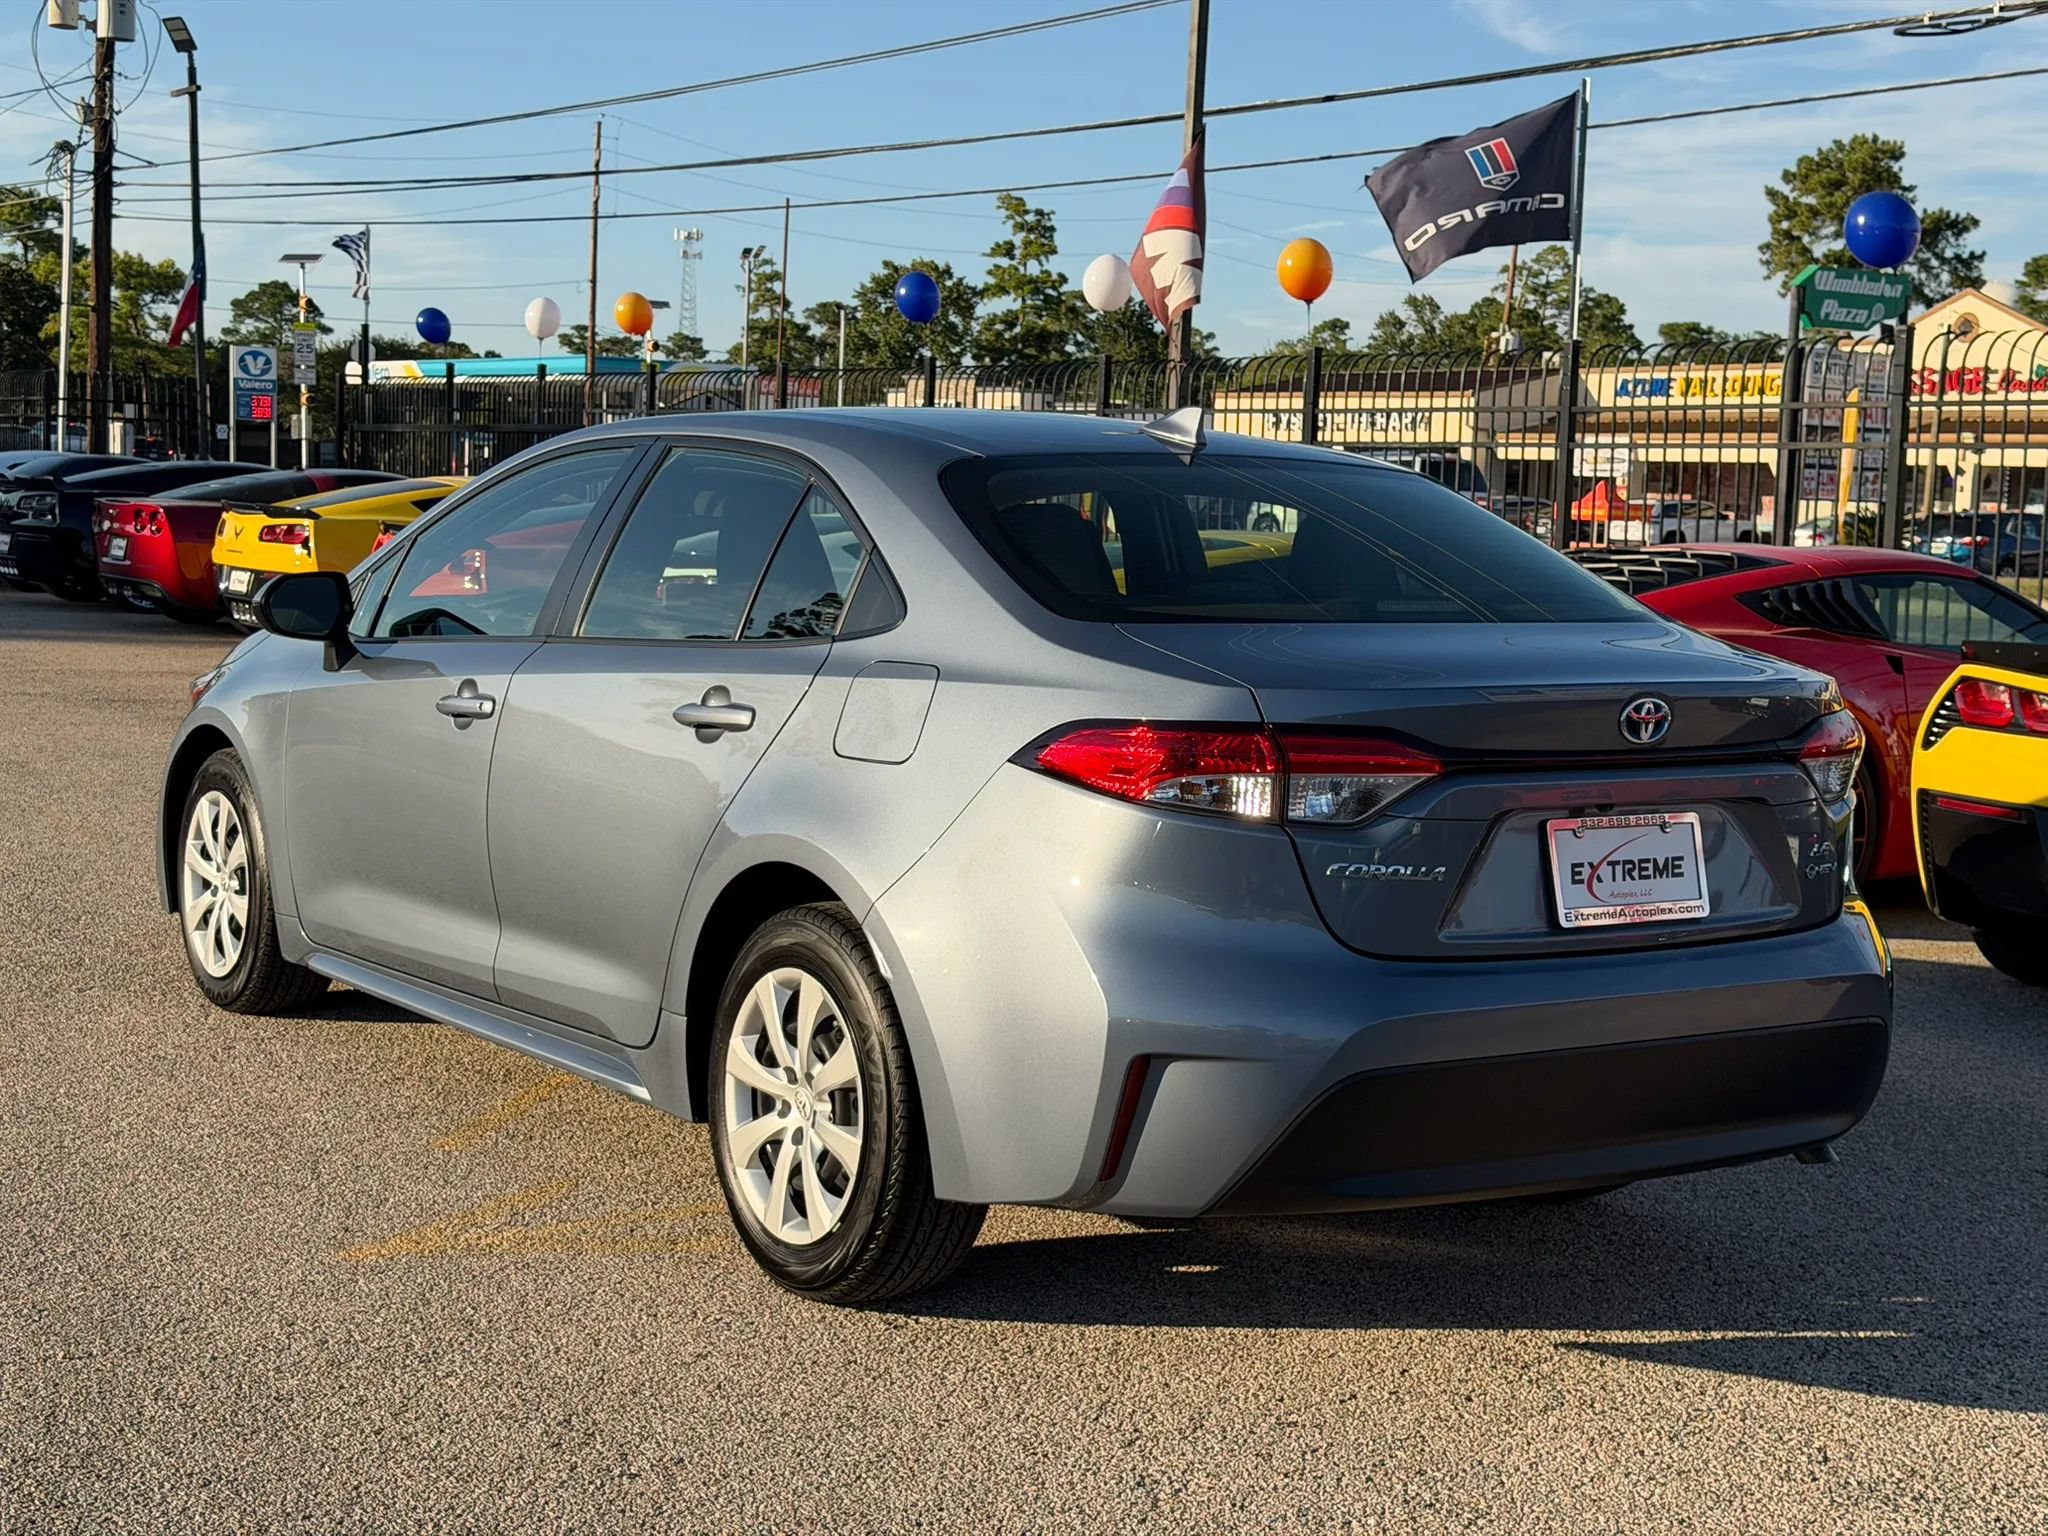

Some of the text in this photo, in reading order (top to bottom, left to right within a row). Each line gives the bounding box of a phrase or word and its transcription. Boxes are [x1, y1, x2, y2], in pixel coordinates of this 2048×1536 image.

[1814, 269, 1904, 298] Wimbledon
[1820, 299, 1869, 323] Plaza
[297, 343, 313, 353] 25
[238, 379, 273, 389] Valero
[1326, 863, 1446, 881] COROLLA
[1570, 856, 1685, 885] EXTREME
[1565, 904, 1705, 923] ExtremeAutoplex.com
